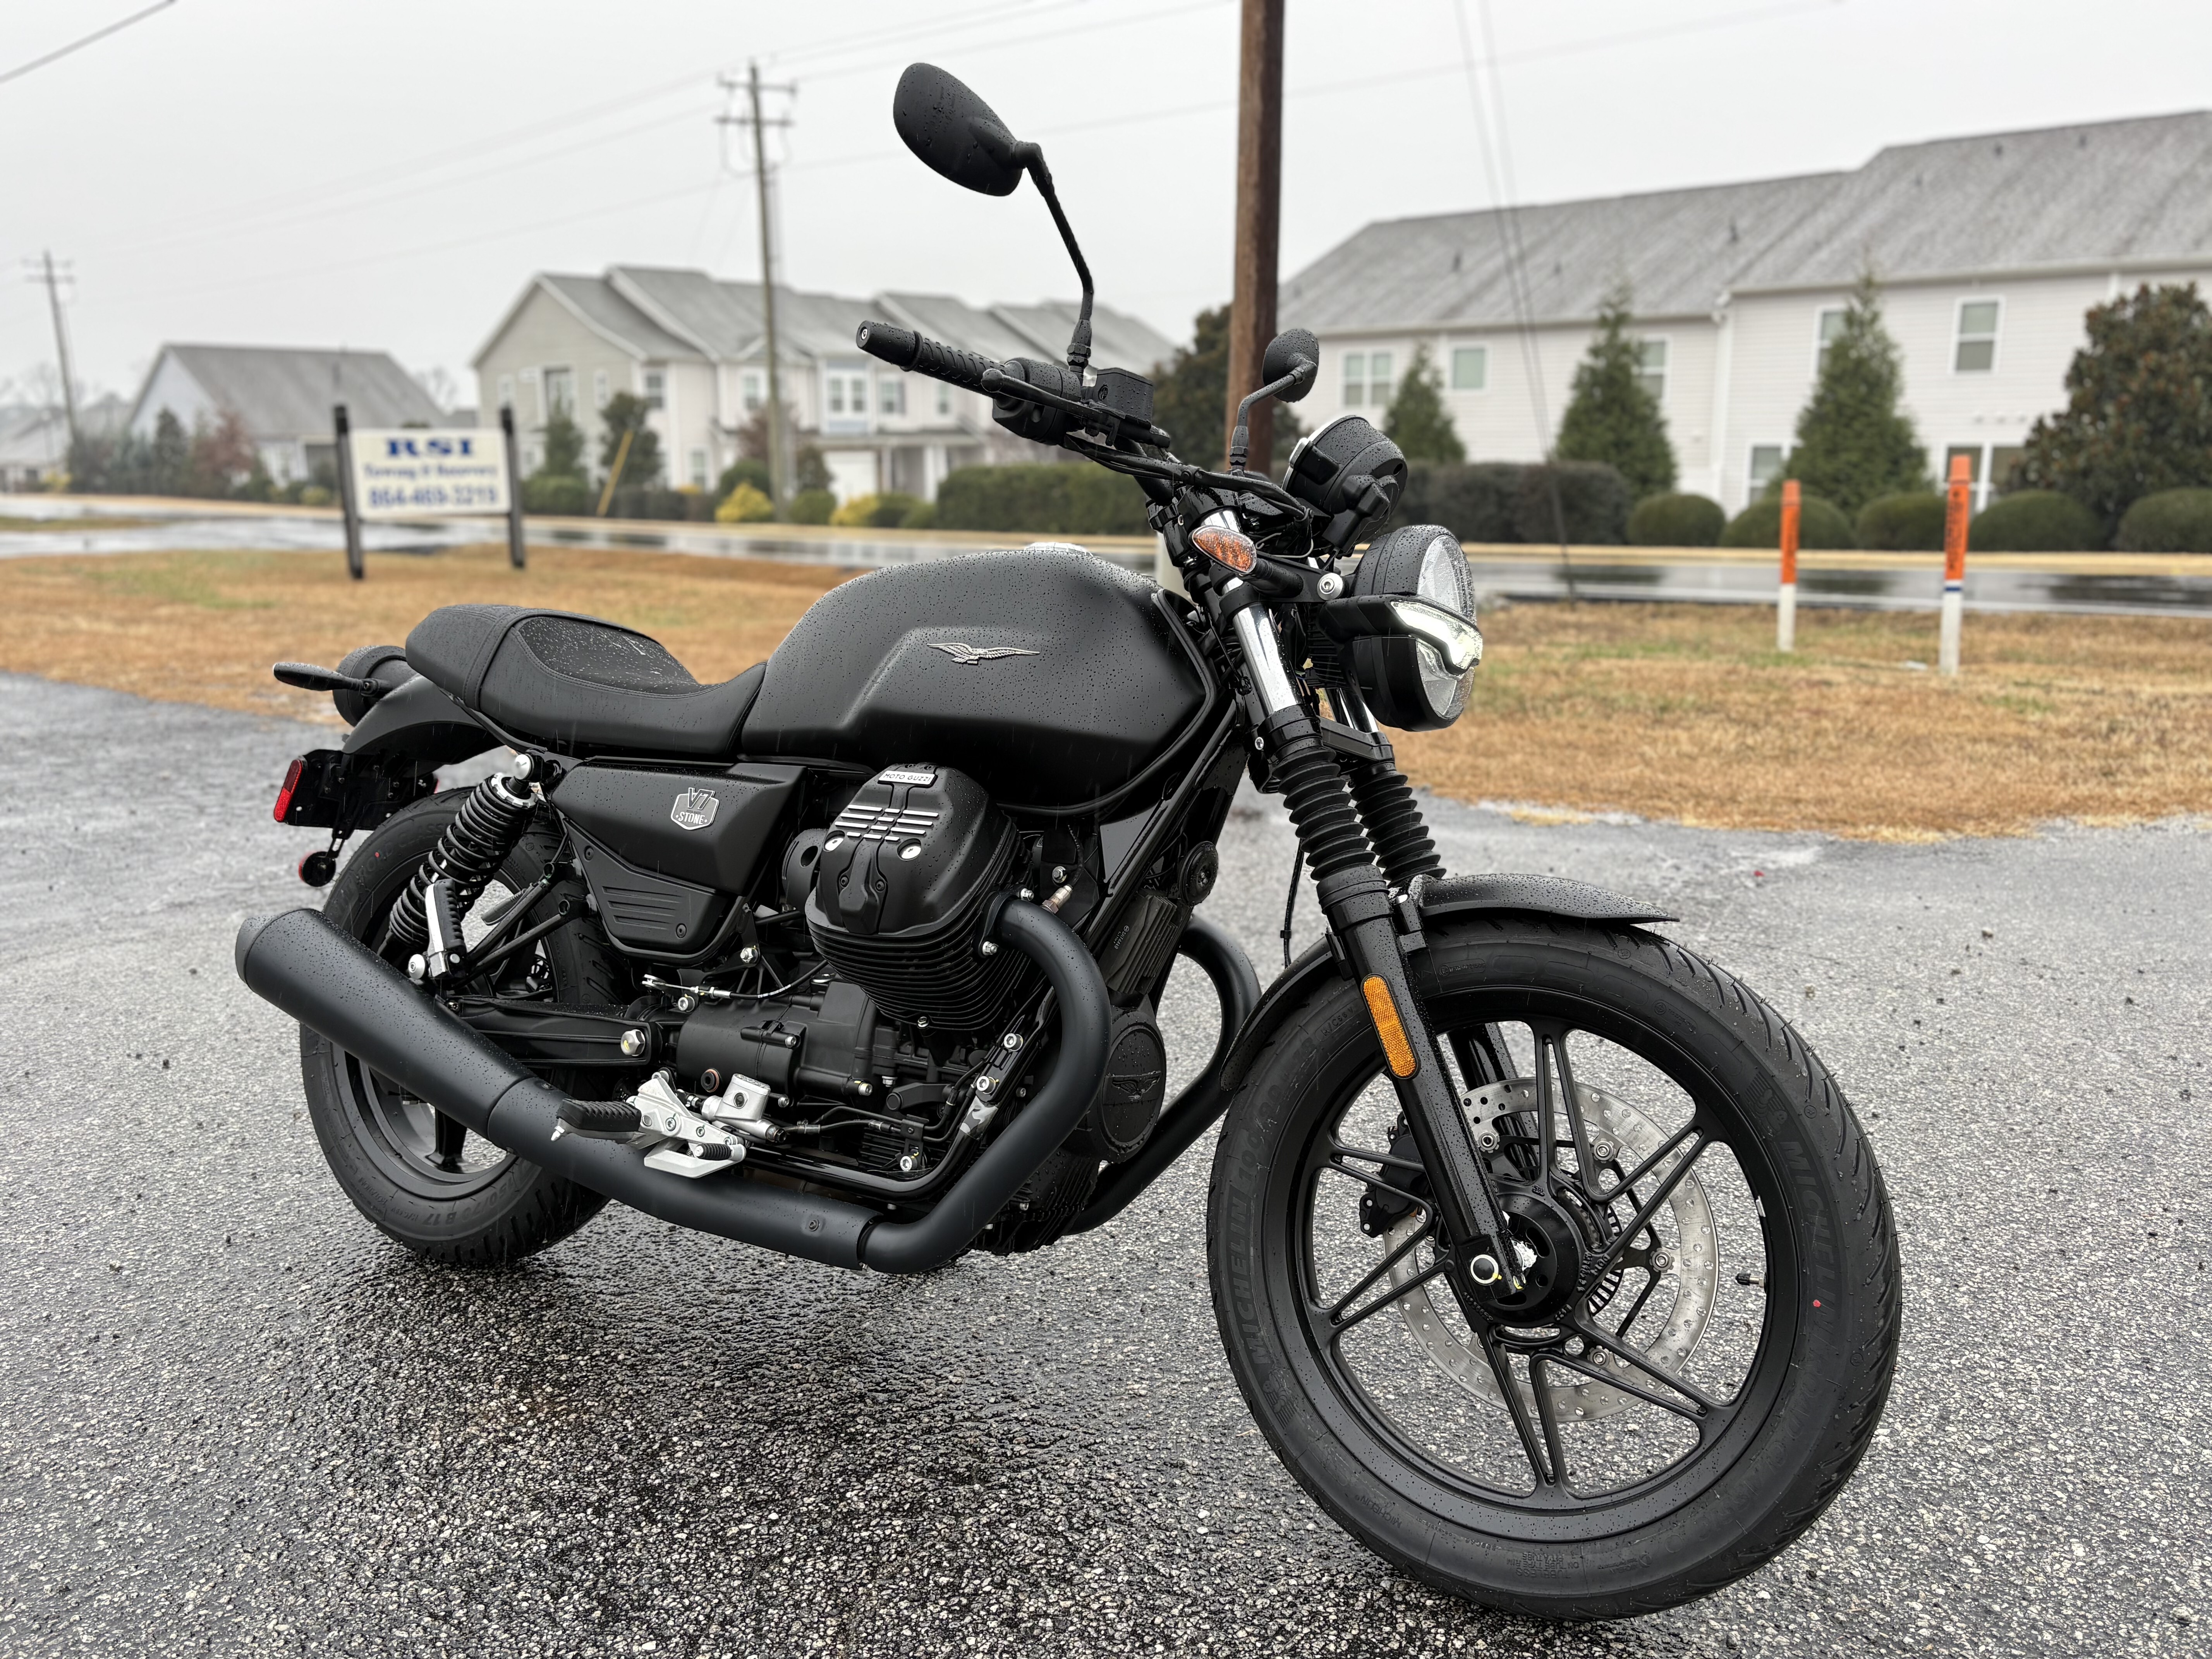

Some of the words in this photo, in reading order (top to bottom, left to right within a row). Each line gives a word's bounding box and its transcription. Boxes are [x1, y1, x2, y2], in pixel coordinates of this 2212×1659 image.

[387, 438, 472, 457] RSI
[688, 787, 715, 810] V7
[678, 812, 705, 824] STONE
[1231, 1196, 1271, 1364] MICHELIN
[1360, 1495, 1403, 1528] MICHELIN
[1515, 1567, 1571, 1578] TUBELESS
